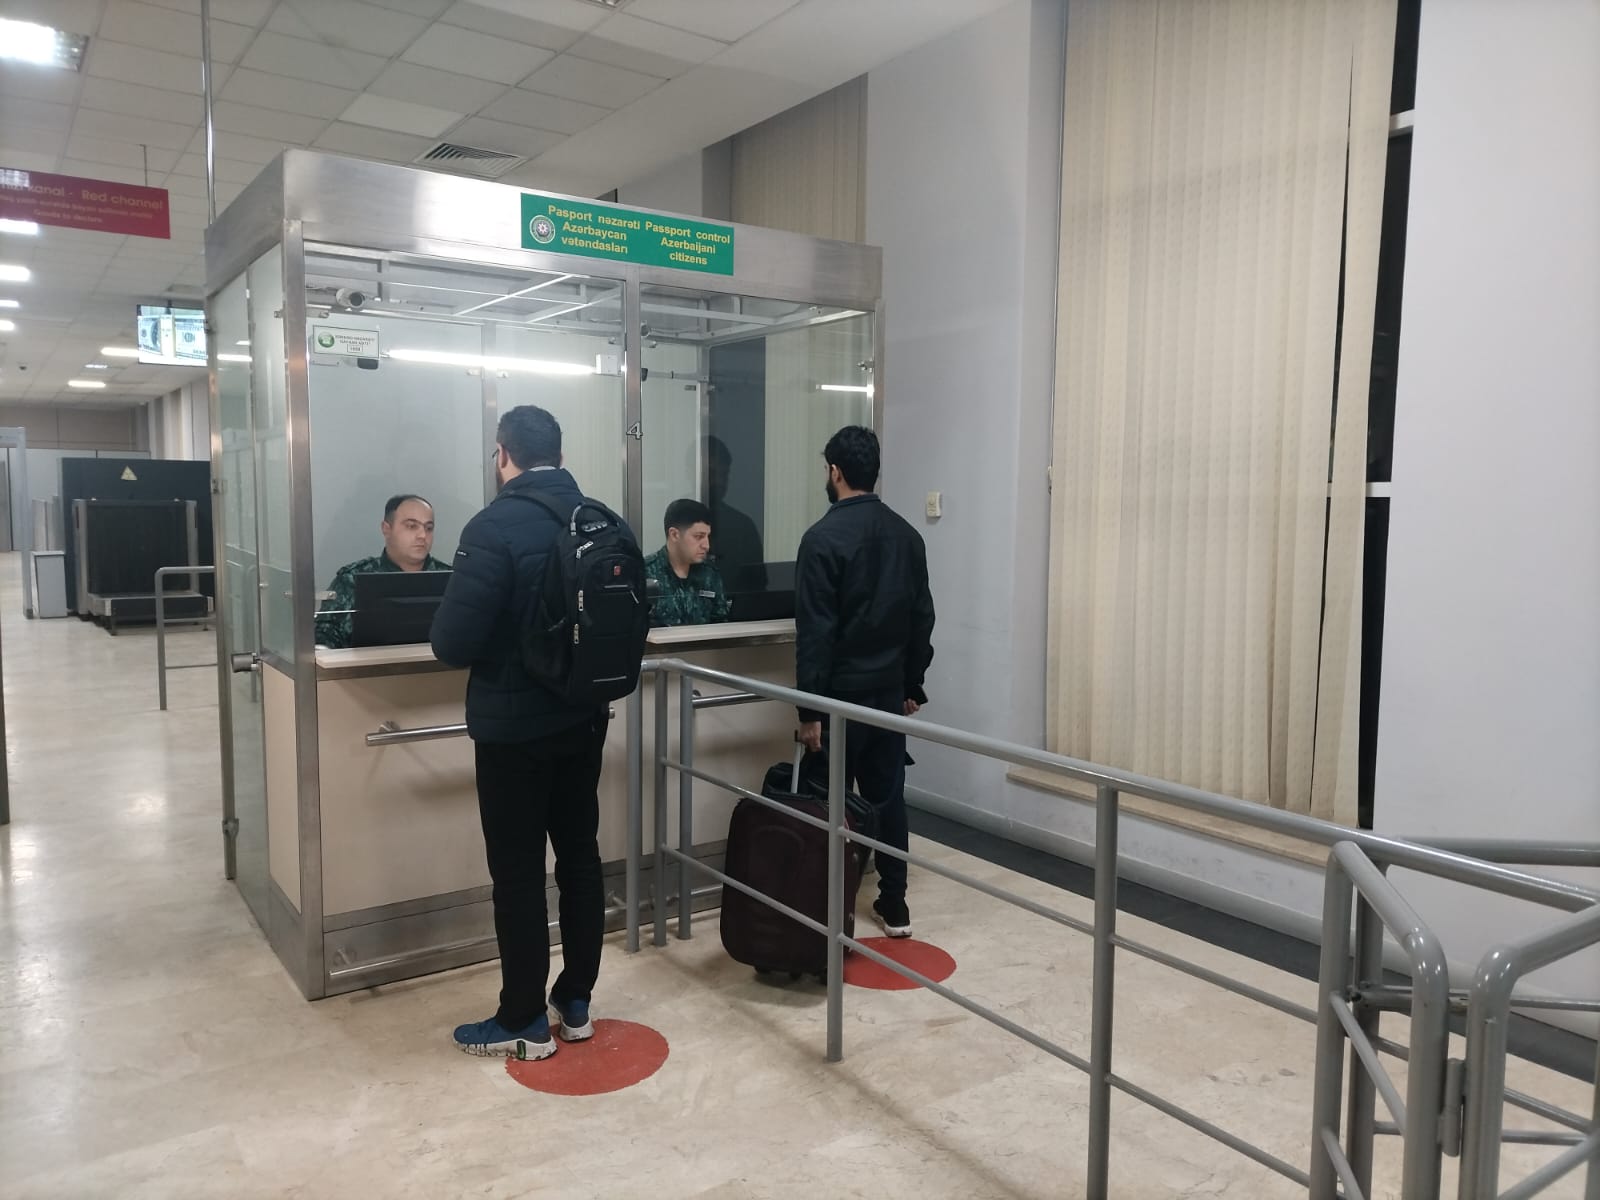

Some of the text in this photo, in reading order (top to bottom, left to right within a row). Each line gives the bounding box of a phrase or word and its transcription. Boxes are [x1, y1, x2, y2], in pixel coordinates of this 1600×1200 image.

[82, 190, 107, 202] Red
[111, 194, 163, 209] channel
[548, 205, 640, 230] Pasport nəzarəti
[562, 222, 627, 240] Azərbaycan
[645, 221, 730, 244] Passport control
[661, 237, 716, 254] Azerbaijani
[669, 252, 708, 265] citizens
[626, 421, 643, 440] 4
